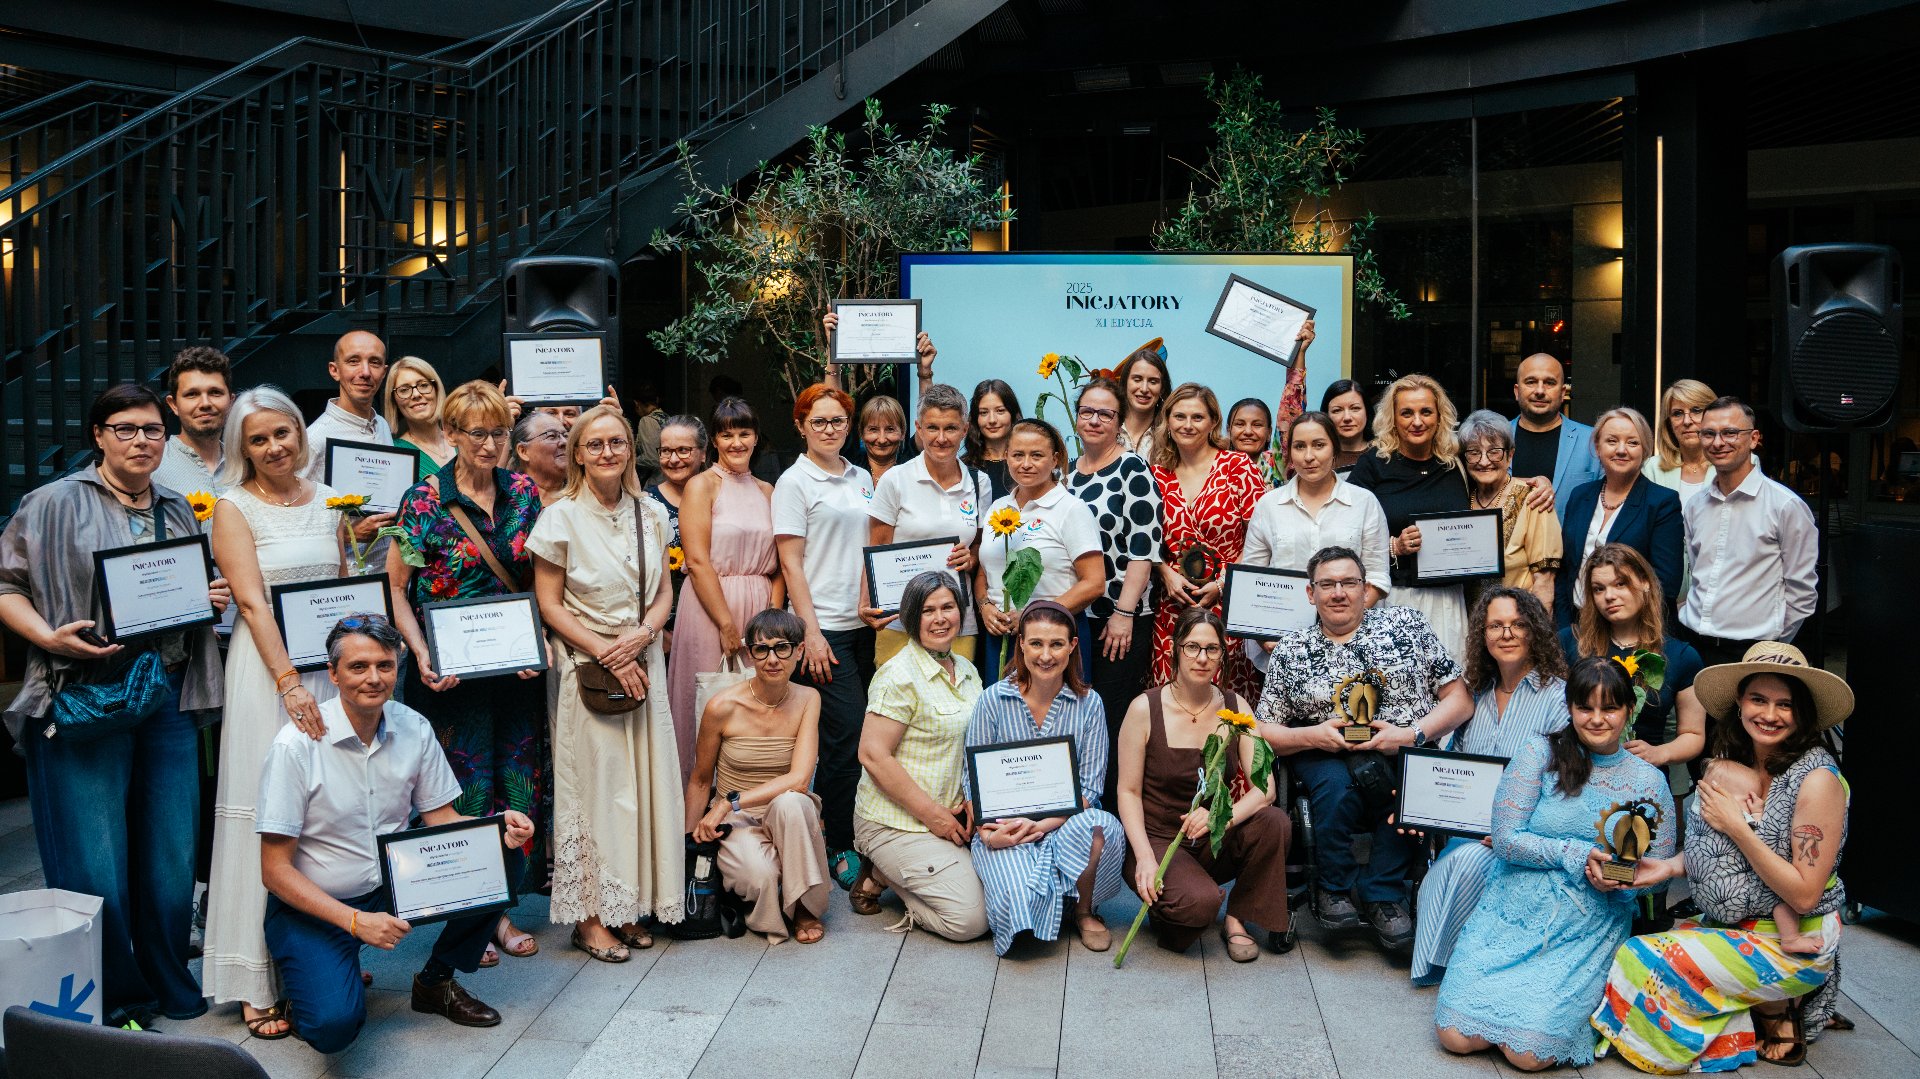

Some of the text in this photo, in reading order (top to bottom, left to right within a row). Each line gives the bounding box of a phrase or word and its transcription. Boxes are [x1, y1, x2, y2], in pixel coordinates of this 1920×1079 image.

[1066, 282, 1093, 294] 2025
[1066, 295, 1184, 310] INICJATORY
[1095, 318, 1154, 328] XI EDYCJA
[132, 557, 177, 571] INICJATORY
[1255, 580, 1295, 590] INICJATORY
[310, 594, 355, 606] INICJATORY
[460, 611, 504, 622] INICJATORY
[1000, 754, 1043, 765] INICJATORY
[1432, 766, 1475, 777] INICJATORY
[419, 839, 470, 854] INICJATORY
